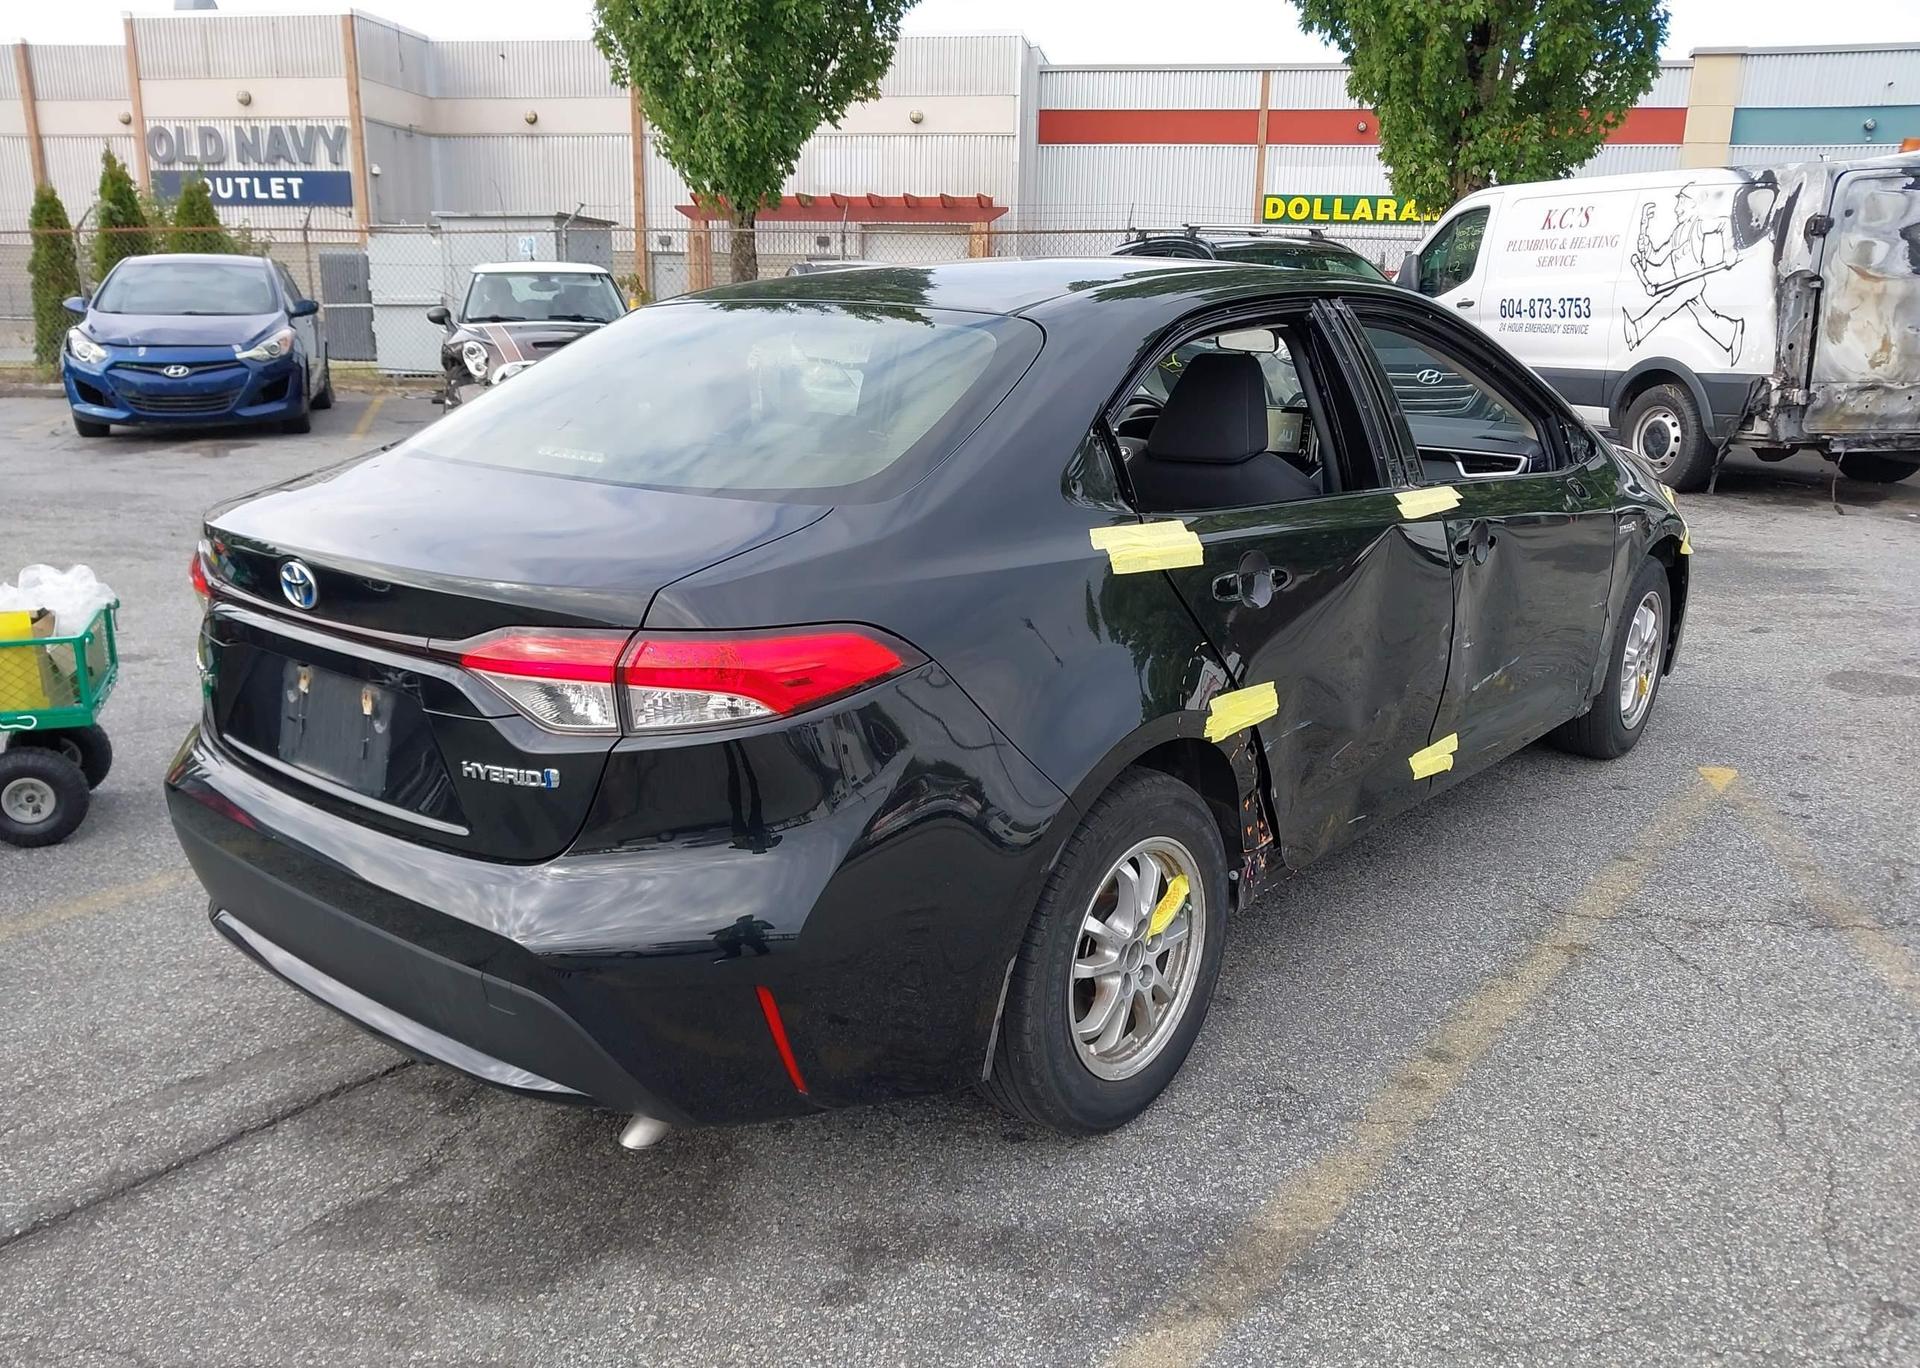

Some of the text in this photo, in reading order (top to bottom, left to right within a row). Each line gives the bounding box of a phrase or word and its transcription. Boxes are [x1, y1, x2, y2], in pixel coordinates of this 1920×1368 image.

[147, 125, 350, 165] OLD NAVY
[1541, 206, 1595, 230] K.C.'S
[1506, 234, 1620, 252] PLUMBING & HEATING
[1536, 255, 1578, 267] SERVICE
[1500, 297, 1591, 319] 604-873-3753
[1499, 322, 1590, 335] 24 HOUR EMERGENCY SERVICE
[461, 761, 541, 788] HYBRID
